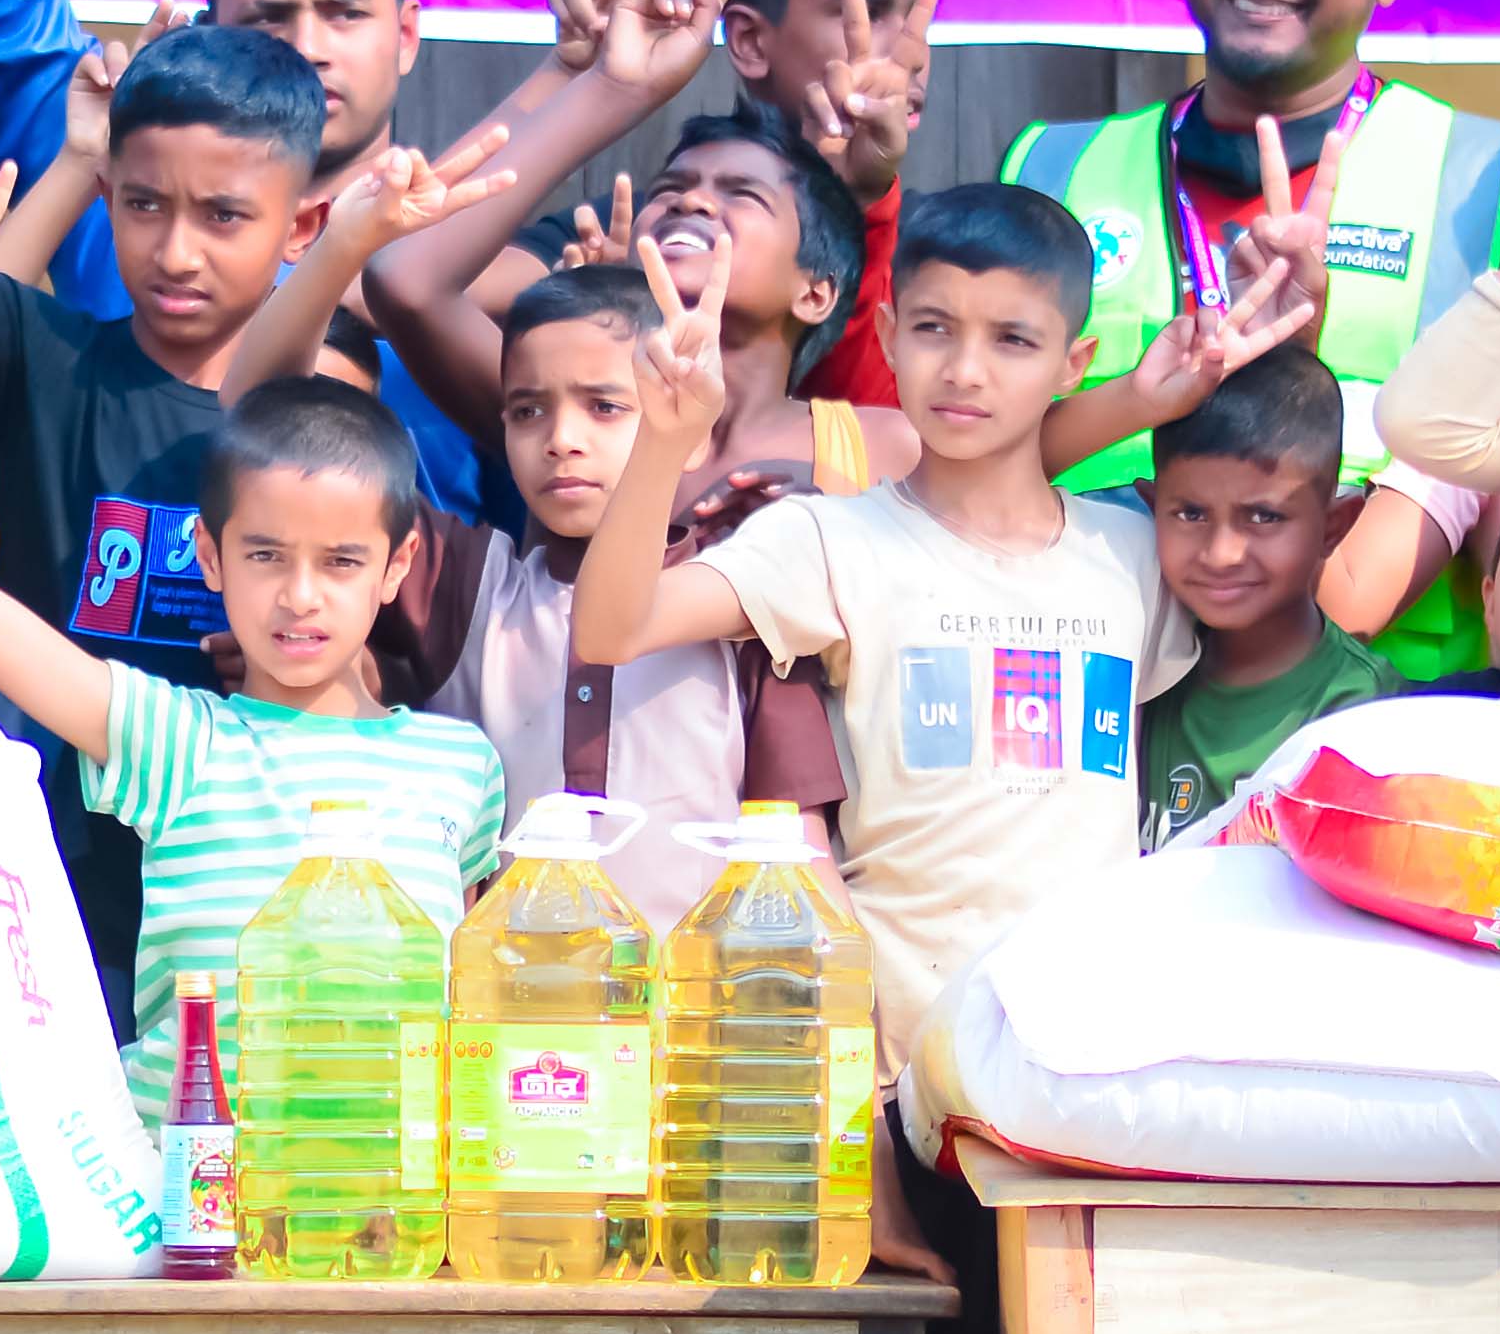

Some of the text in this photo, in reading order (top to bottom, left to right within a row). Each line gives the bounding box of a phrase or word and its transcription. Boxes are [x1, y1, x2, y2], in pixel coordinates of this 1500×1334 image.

[1322, 249, 1407, 275] oundation
[918, 694, 1121, 737] UN IQ UE
[57, 1109, 163, 1257] SUGAR
